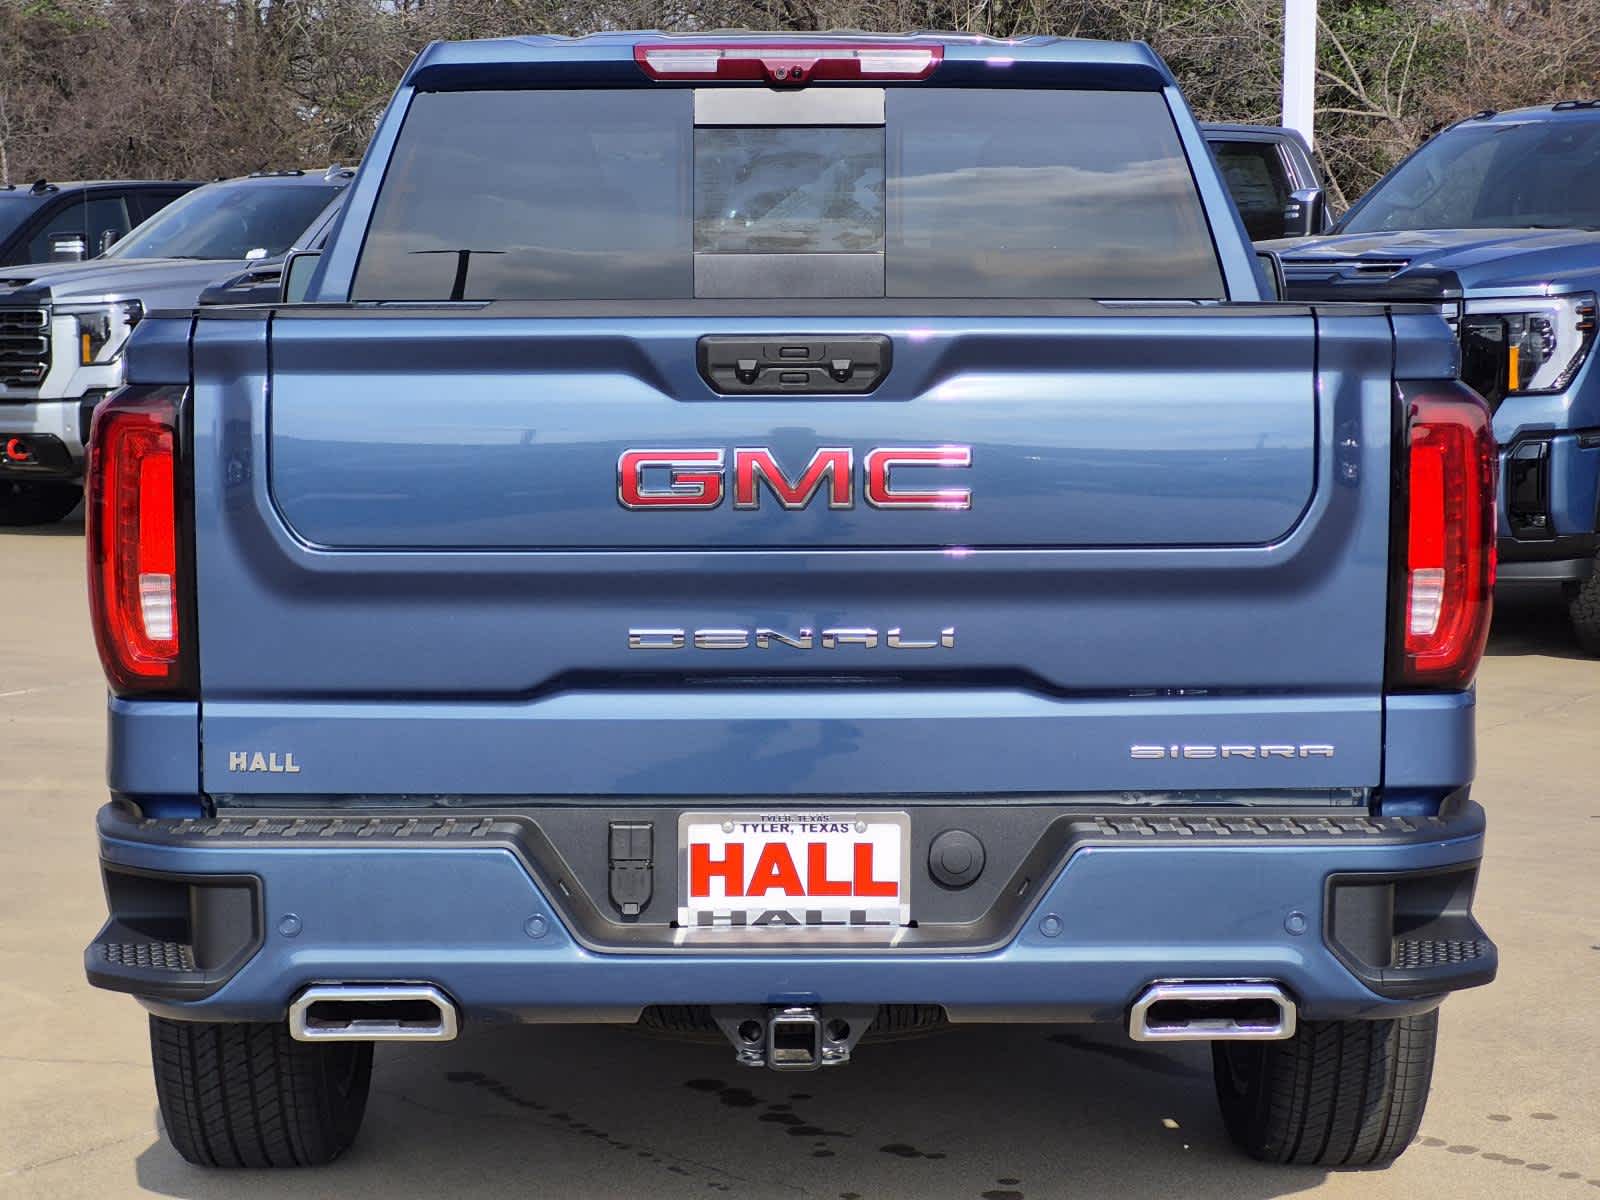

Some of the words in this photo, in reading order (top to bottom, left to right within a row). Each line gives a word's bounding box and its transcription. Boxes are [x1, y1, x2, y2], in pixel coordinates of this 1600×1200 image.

[617, 447, 973, 510] GMC
[628, 626, 955, 650] DENALI
[1130, 744, 1335, 760] SIERRA
[228, 751, 301, 773] HALL
[741, 823, 795, 834] TYLER,
[801, 823, 849, 834] TEXAS
[797, 815, 830, 823] TEXAS
[690, 842, 898, 897] HALL
[697, 910, 891, 926] HALL
